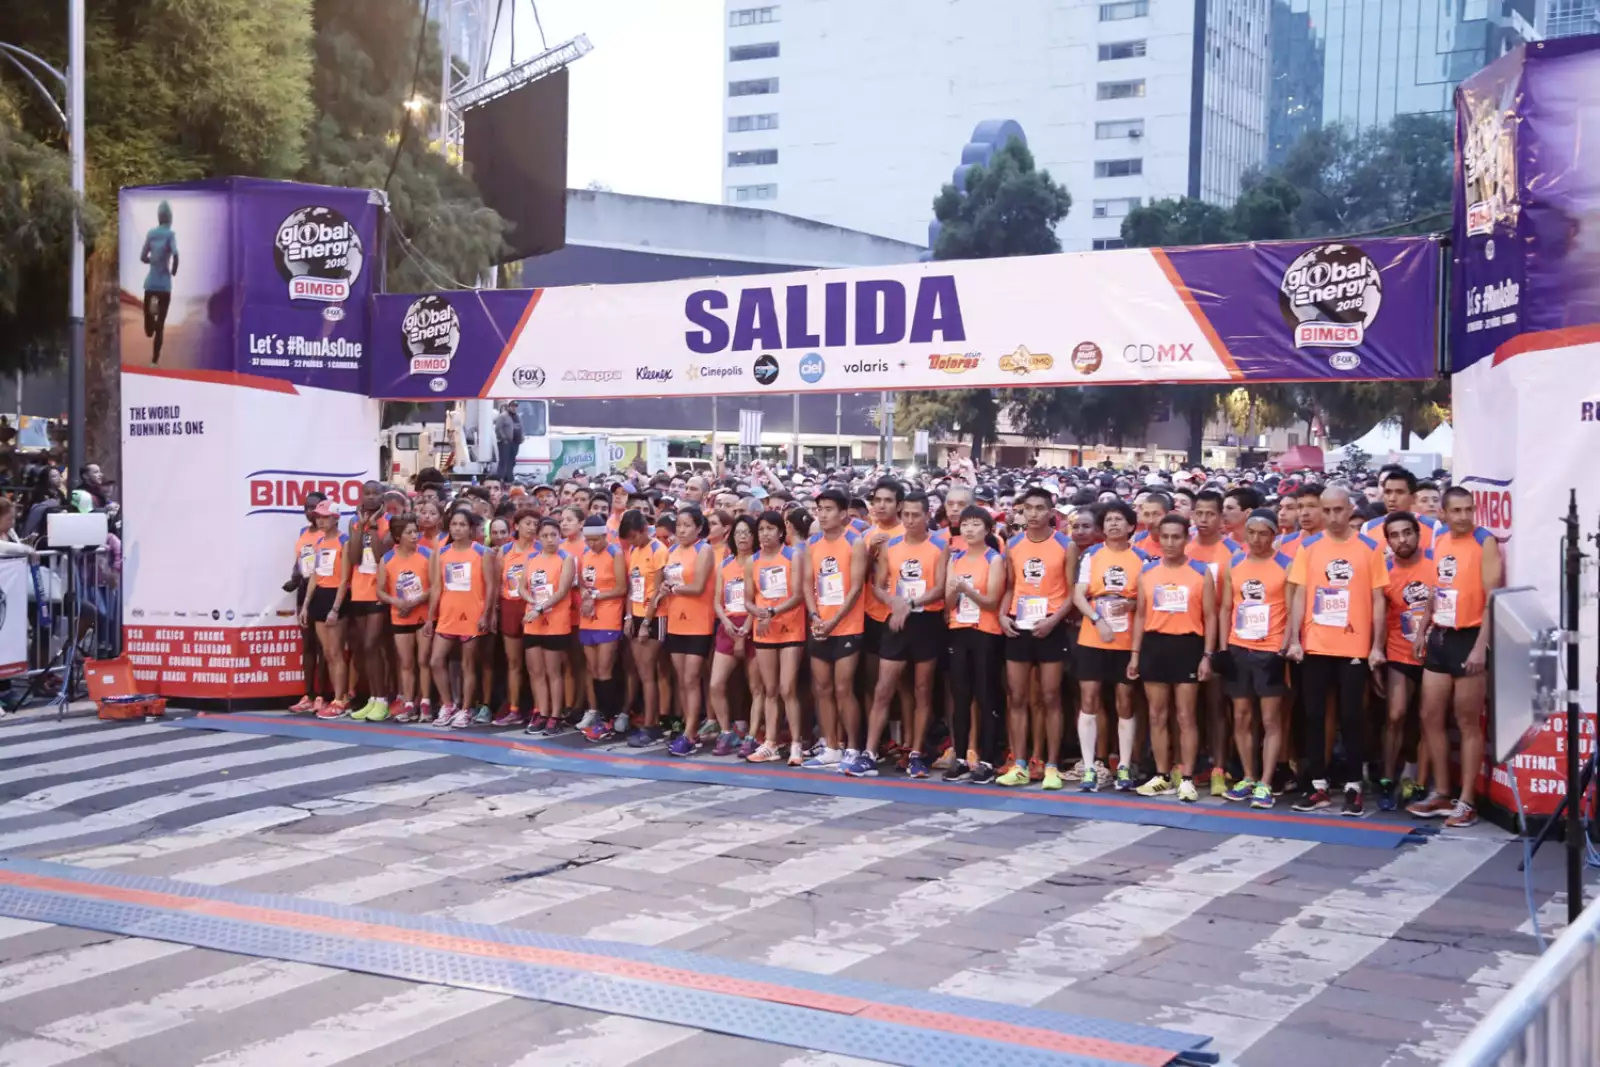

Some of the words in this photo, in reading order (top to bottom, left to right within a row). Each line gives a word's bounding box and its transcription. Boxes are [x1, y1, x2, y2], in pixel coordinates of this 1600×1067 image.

[324, 257, 348, 269] 2016
[294, 282, 345, 296] BIMBO
[685, 275, 966, 354] SALIDA
[1301, 328, 1359, 341] BIMBO
[287, 335, 362, 358] #RunAsOne
[1122, 343, 1194, 363] CDMX
[413, 360, 447, 370] BIMBO
[801, 360, 823, 374] ciel
[843, 358, 889, 373] volaris
[518, 369, 539, 381] FOX
[577, 369, 622, 382] Kappa
[130, 407, 146, 420] THE
[148, 405, 180, 420] WORLD
[130, 422, 170, 436] RUNNING
[172, 422, 183, 435] AS
[185, 421, 204, 435] ONE
[240, 630, 274, 641] COSTA
[250, 642, 297, 654] ECUADOR
[260, 656, 287, 667] CHILE
[233, 670, 269, 684] ESPAÑA
